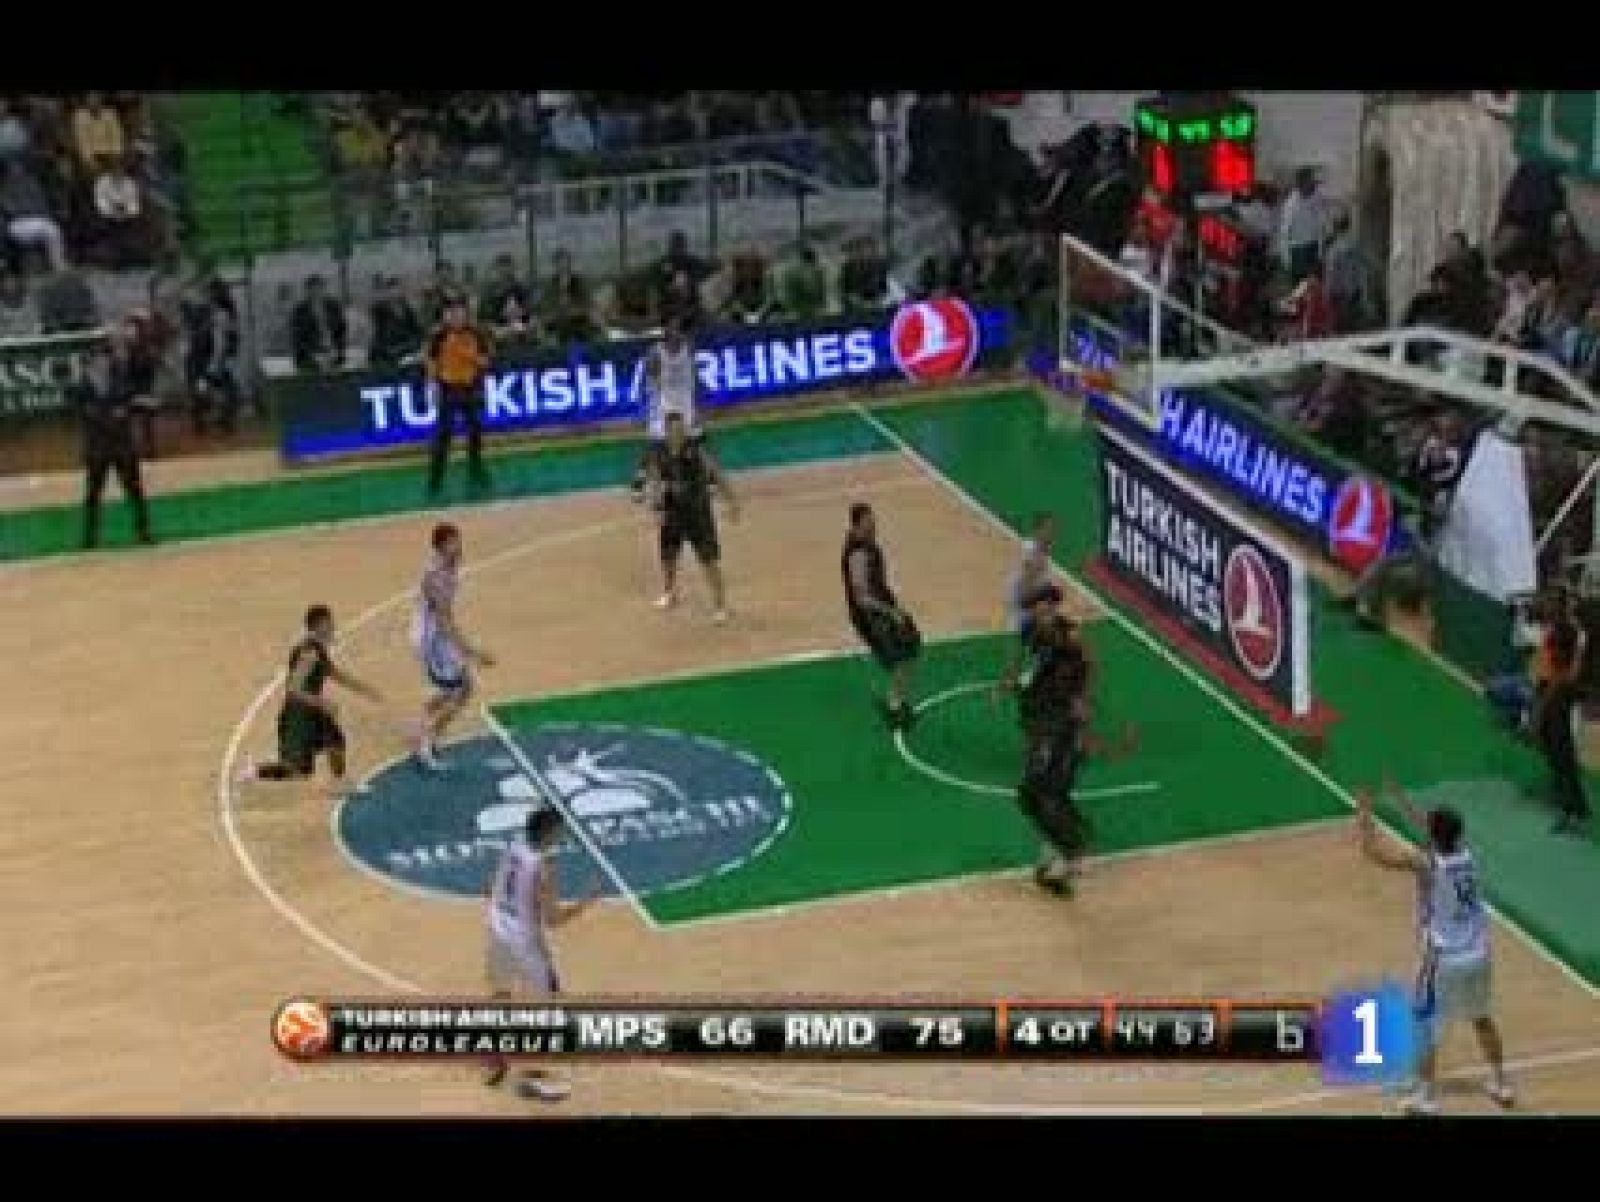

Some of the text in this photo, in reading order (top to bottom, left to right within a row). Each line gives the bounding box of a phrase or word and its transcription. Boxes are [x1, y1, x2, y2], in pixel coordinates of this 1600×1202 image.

[360, 360, 614, 429] TUKISH
[1105, 457, 1221, 581] TURKISH
[1182, 408, 1328, 523] AIRLINES
[1107, 514, 1222, 633] AIRLINES
